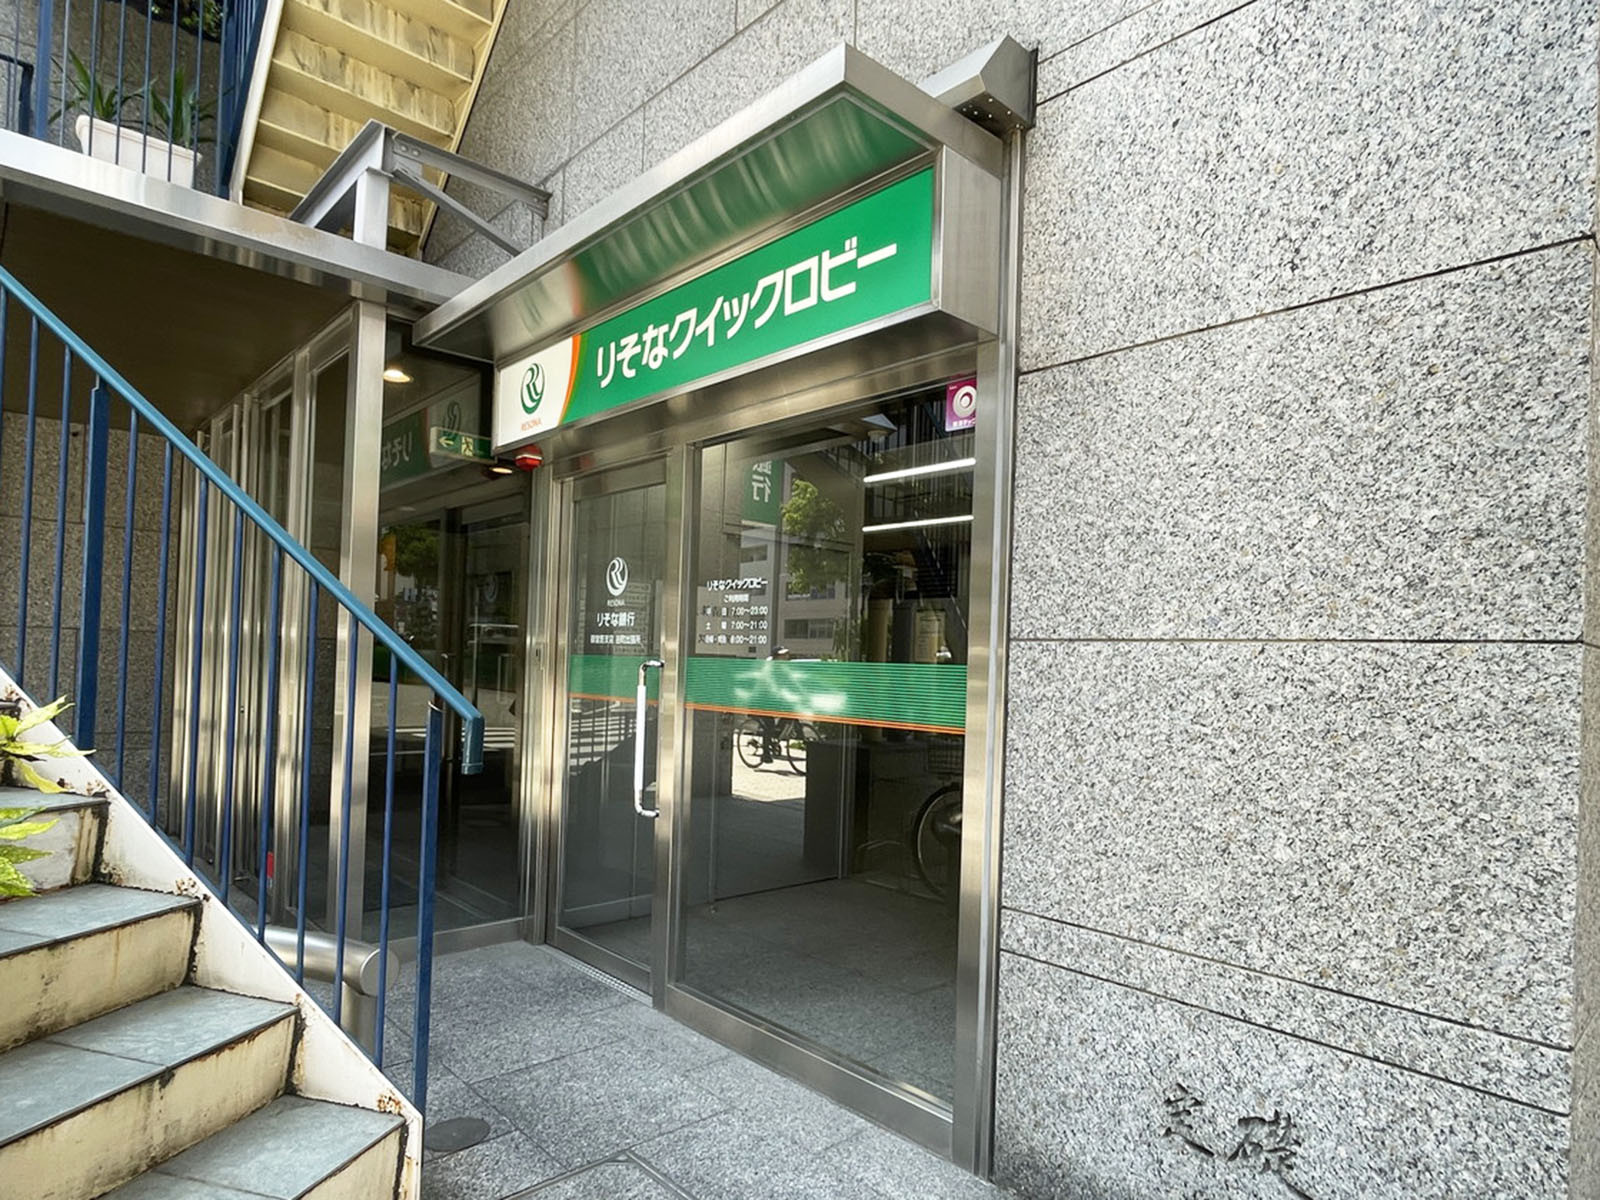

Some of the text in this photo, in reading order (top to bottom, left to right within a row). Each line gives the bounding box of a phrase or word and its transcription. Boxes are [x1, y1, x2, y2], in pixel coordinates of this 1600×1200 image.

[596, 236, 898, 389] りそなクイックロビー
[706, 577, 769, 591] りそなクイックロビー
